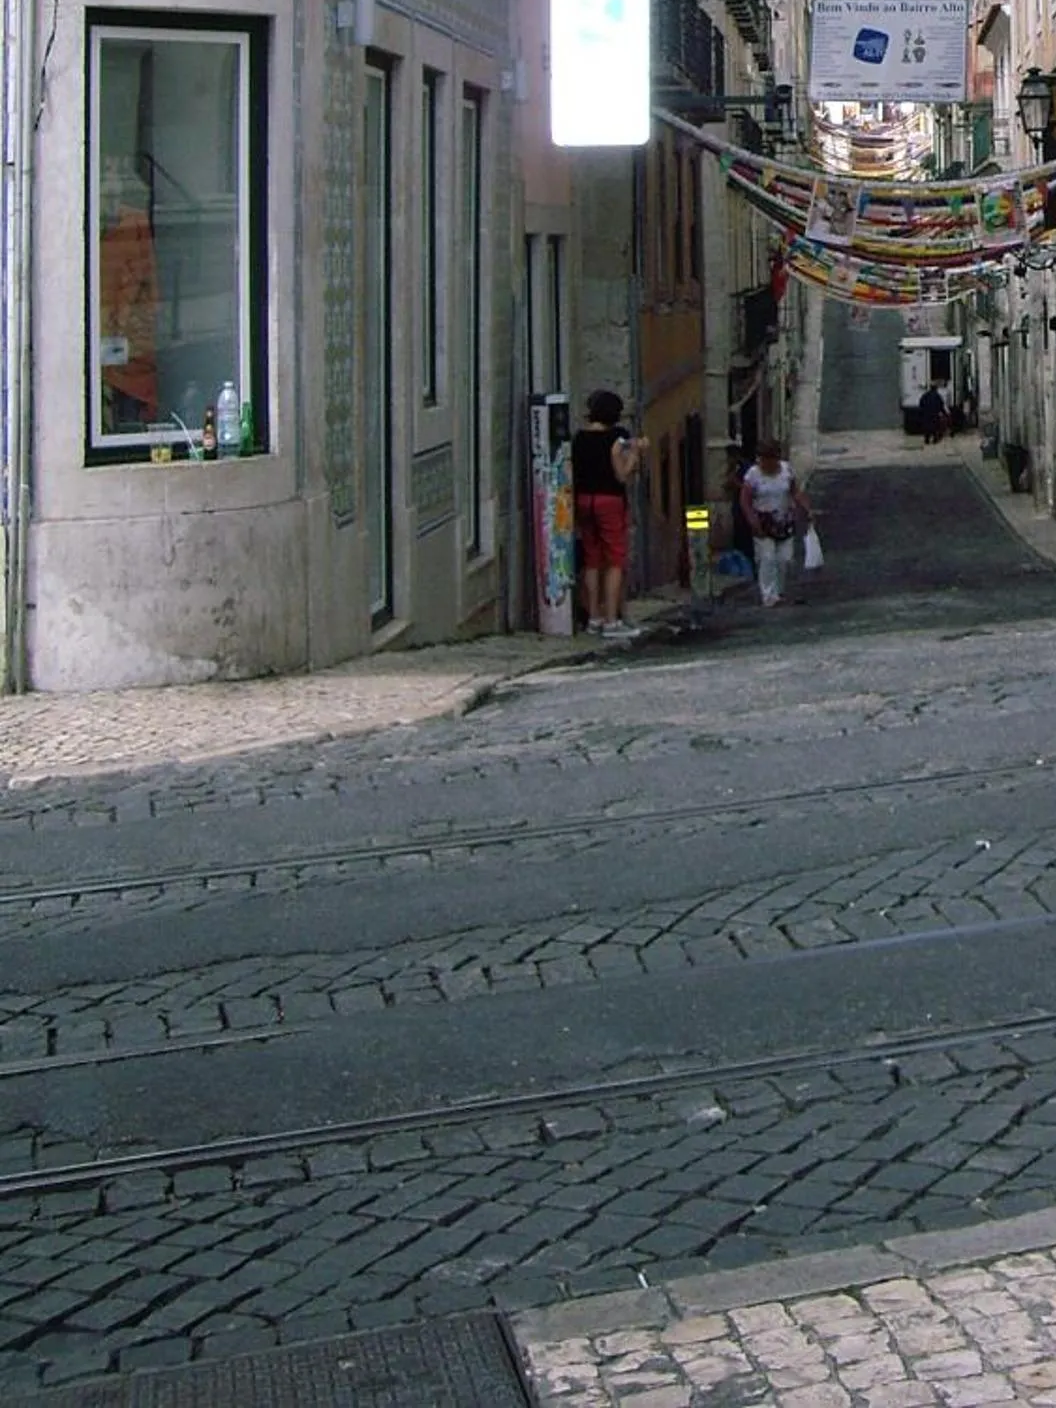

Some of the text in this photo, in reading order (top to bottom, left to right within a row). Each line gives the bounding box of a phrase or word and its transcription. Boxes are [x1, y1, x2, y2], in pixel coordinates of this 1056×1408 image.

[817, 2, 964, 13] Bem Vindo ao Bairro Alto
